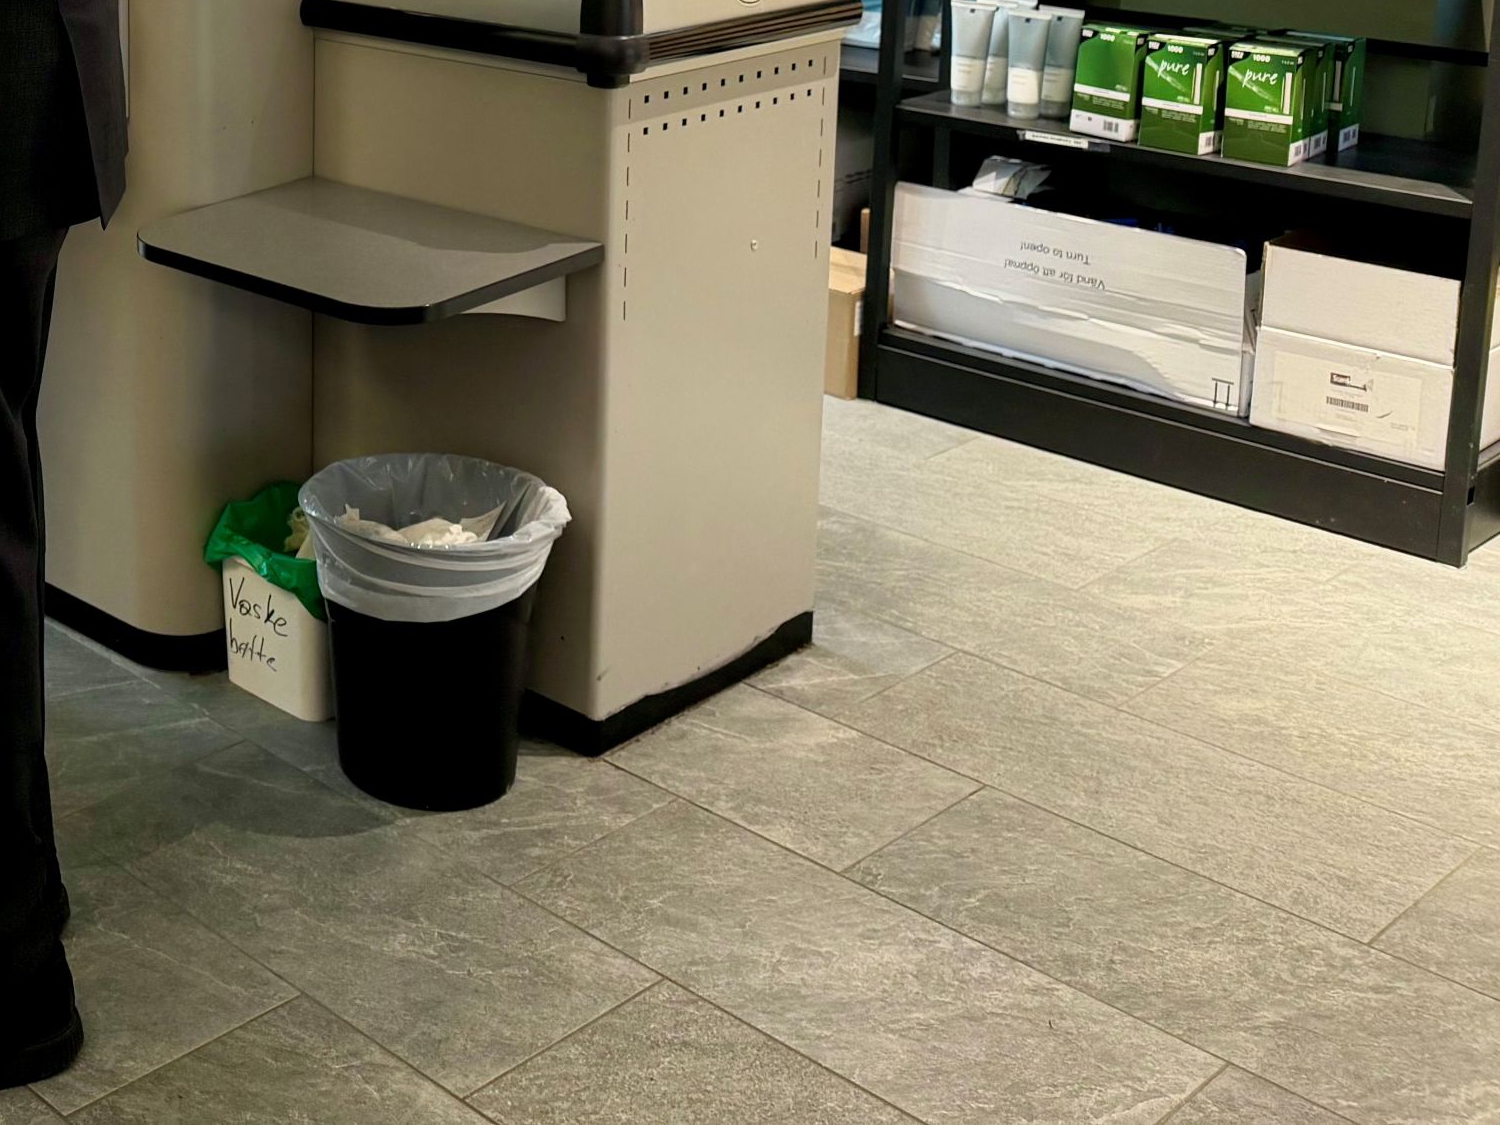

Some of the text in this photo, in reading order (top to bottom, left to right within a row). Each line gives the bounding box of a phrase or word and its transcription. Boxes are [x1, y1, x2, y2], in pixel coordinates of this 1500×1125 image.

[1167, 45, 1184, 54] 1000
[1157, 59, 1189, 77] pure
[1253, 55, 1271, 63] 1000
[1242, 69, 1278, 87] pure
[1020, 241, 1090, 266] Turn to open!
[1076, 275, 1105, 290] Vänd
[229, 577, 288, 637] Vaske
